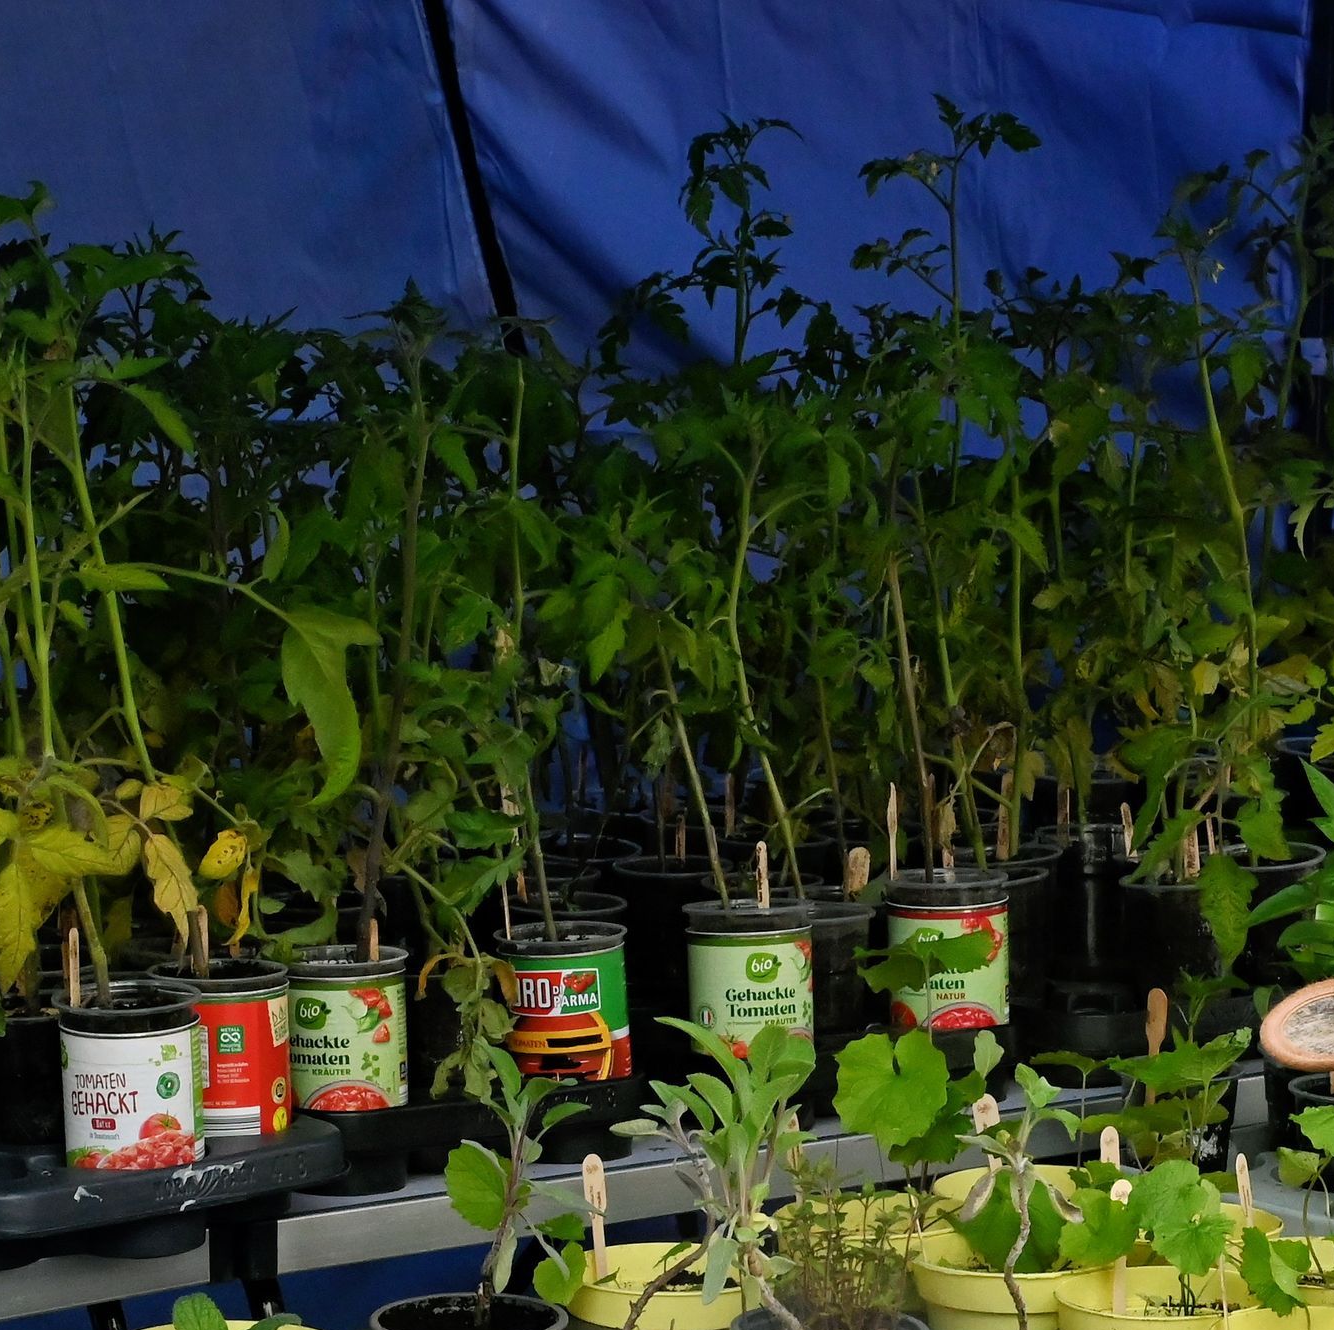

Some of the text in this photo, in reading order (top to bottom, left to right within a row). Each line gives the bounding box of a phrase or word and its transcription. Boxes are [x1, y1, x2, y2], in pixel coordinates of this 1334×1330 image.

[751, 957, 773, 973] bio
[924, 977, 965, 990] aten
[554, 992, 597, 1008] PARMA
[725, 986, 796, 1002] Gehackte
[936, 992, 966, 1000] NATUR
[299, 1001, 320, 1019] bio
[725, 1003, 796, 1018] Tomaten
[765, 1017, 797, 1026] KRÄUTER
[290, 1034, 350, 1049] ehackte
[311, 1067, 351, 1076] KRÄUTER
[75, 1072, 126, 1090] TOMATEN
[71, 1090, 139, 1116] GEHACKT
